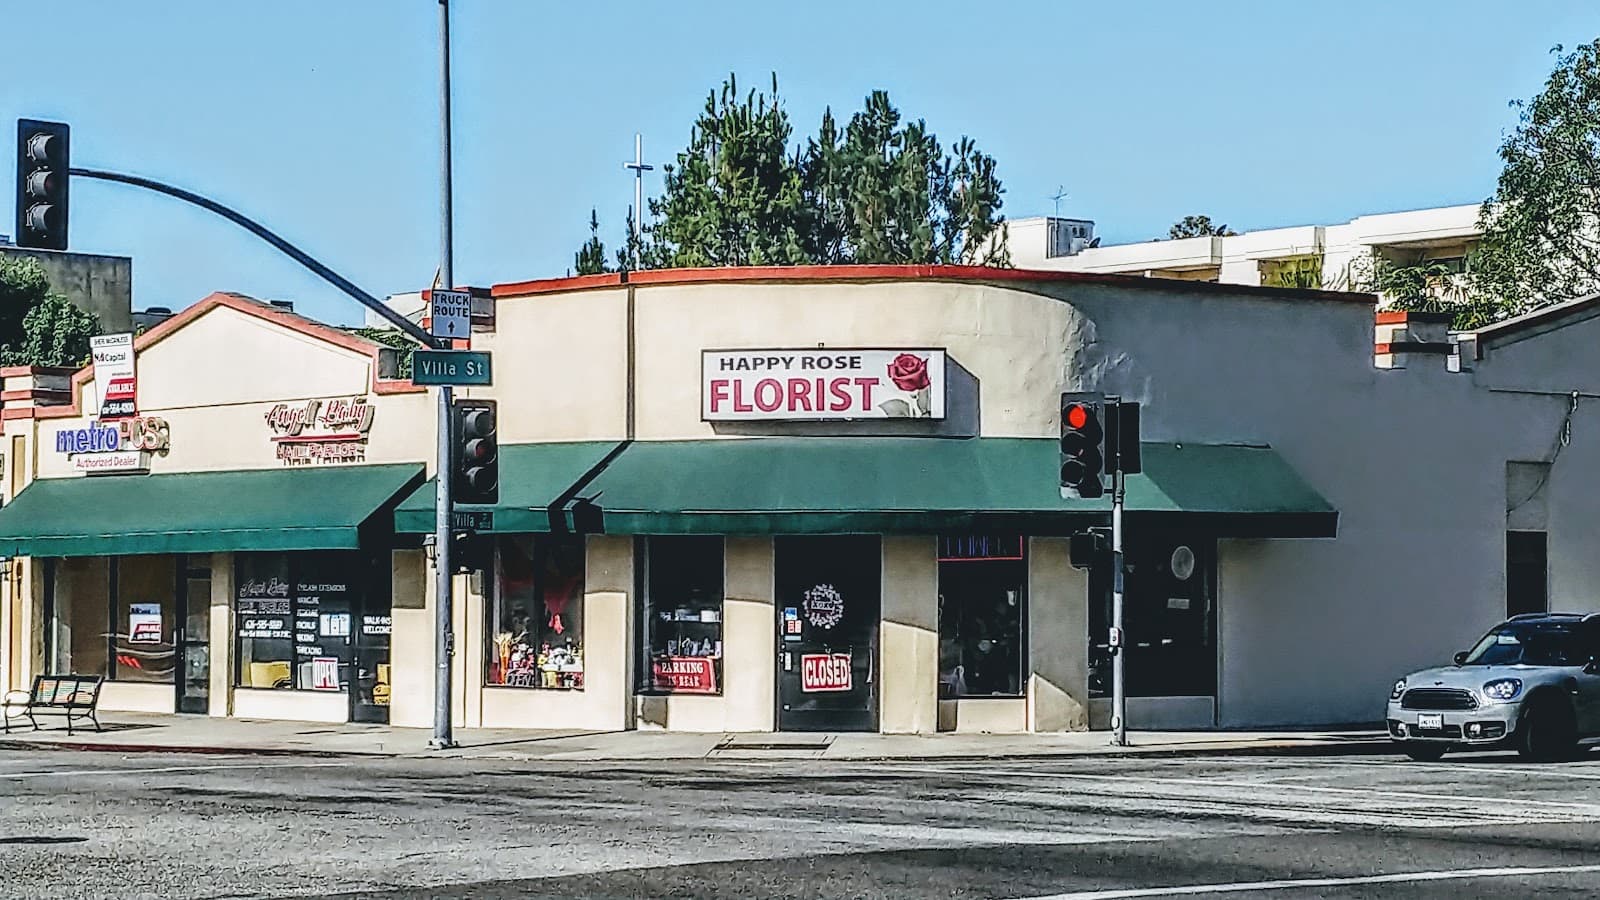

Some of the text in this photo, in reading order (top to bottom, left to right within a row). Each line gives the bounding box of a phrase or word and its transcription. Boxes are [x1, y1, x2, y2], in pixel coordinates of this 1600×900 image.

[433, 293, 469, 305] TRUCK
[433, 305, 469, 317] ROUTE
[105, 351, 126, 363] Capital
[719, 355, 862, 371] HAPPY ROSE
[422, 360, 483, 376] Villa St
[710, 377, 880, 413] FLORIST
[267, 394, 367, 434] Angel Baby
[276, 444, 357, 459] NAIL PARLOR
[76, 455, 137, 468] Authorized Dealer
[455, 513, 475, 528] Villa
[315, 661, 337, 687] OPEN
[661, 662, 704, 674] PARKING
[805, 658, 849, 687] CLOSED
[668, 675, 700, 687] IN REAR
